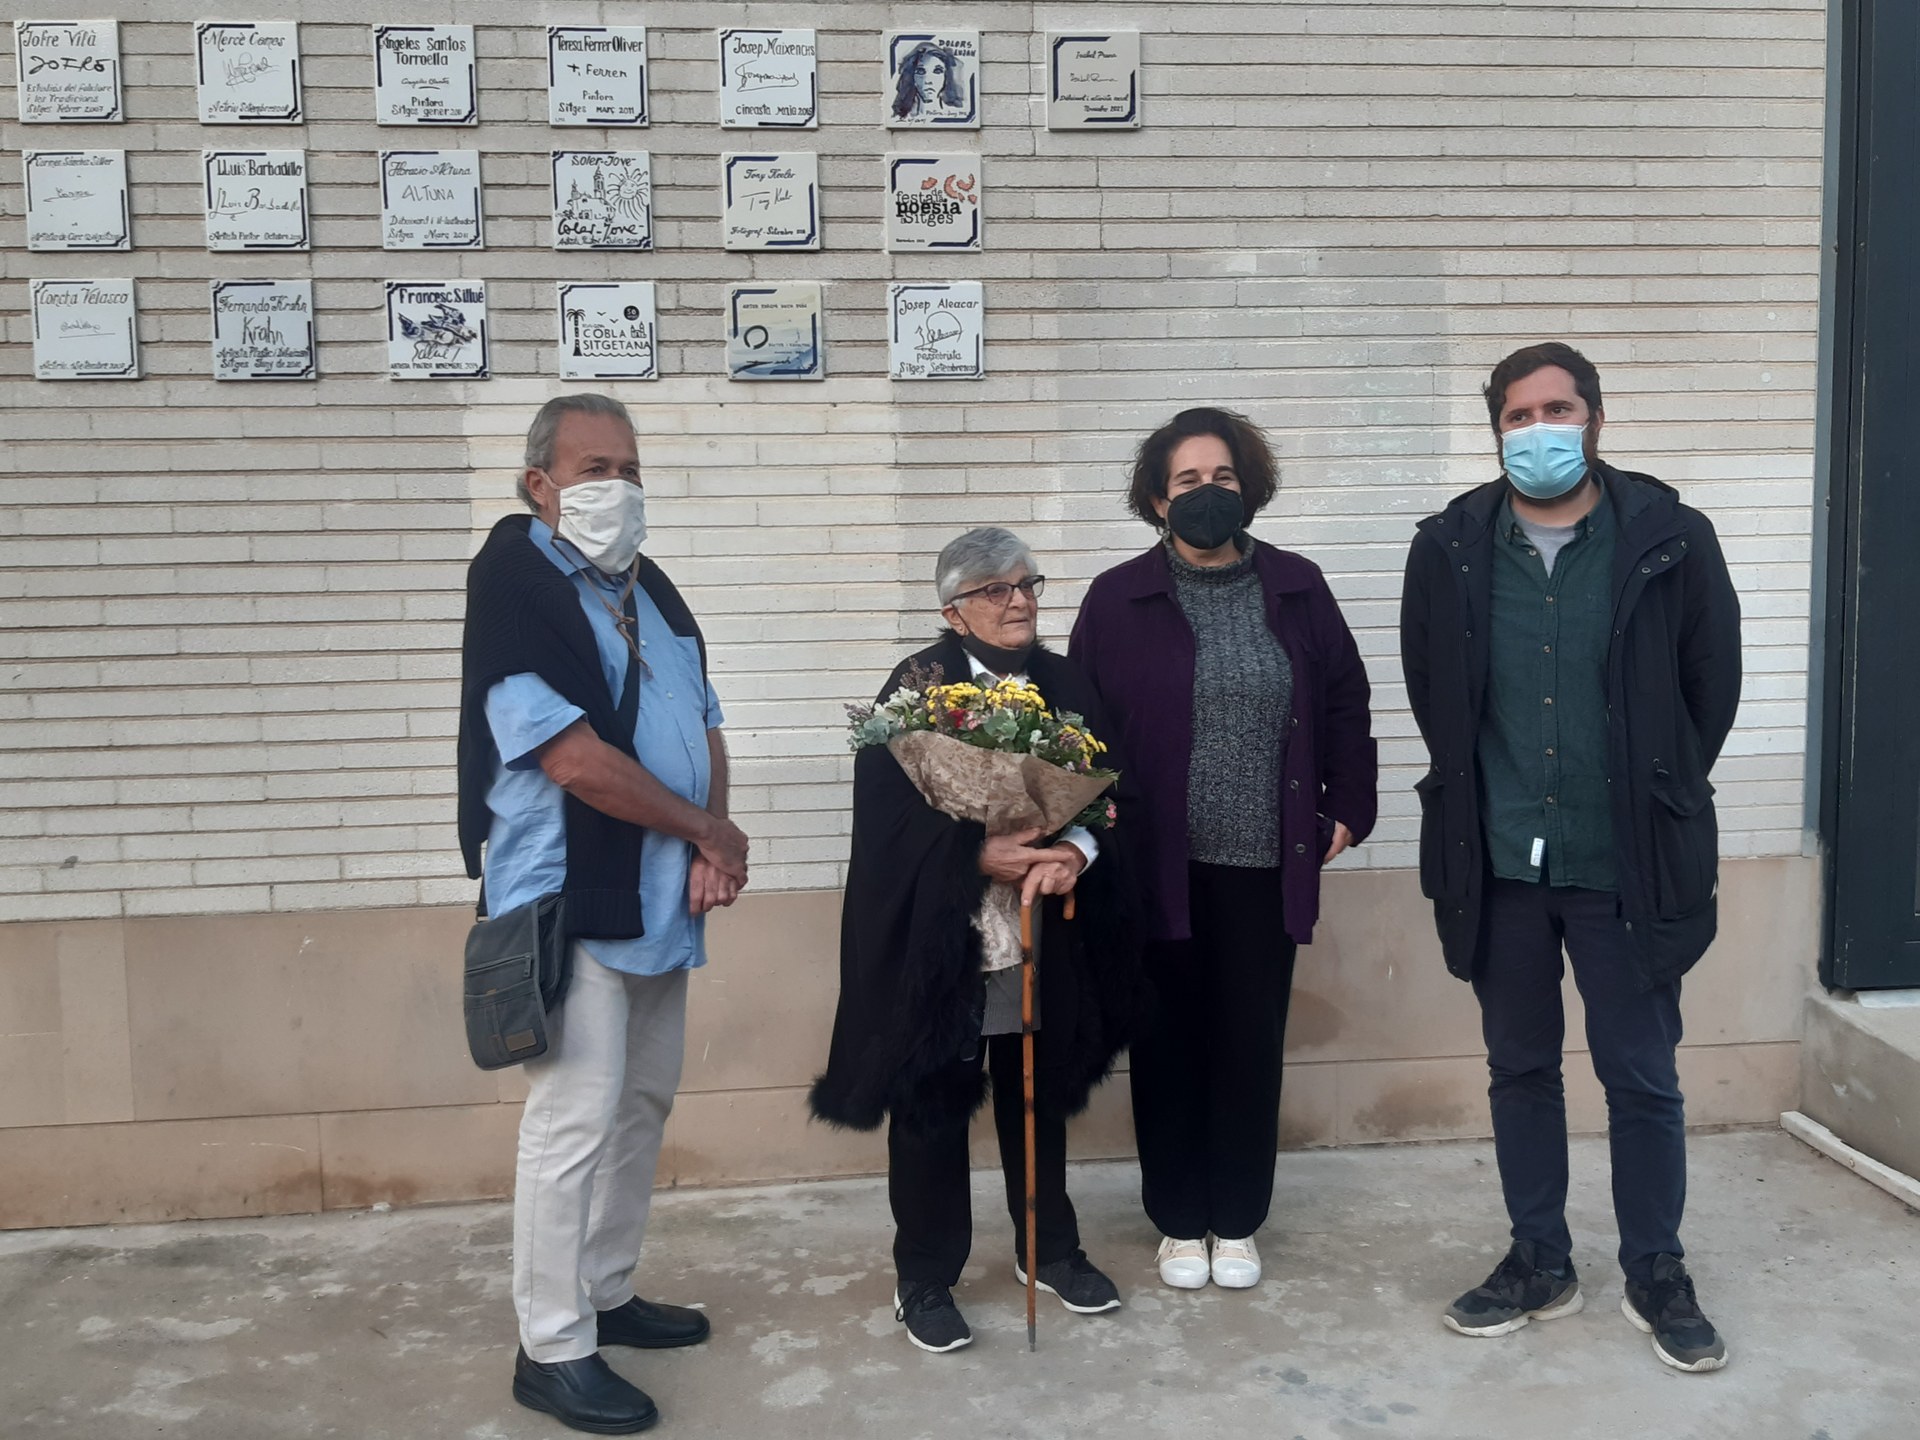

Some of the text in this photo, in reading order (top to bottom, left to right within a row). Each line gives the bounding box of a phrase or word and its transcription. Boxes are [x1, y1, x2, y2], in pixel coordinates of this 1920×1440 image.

[23, 29, 96, 47] Jofre Vilà
[426, 35, 467, 52] Santos
[555, 35, 643, 52] Teresa Ferrer Oliver
[733, 36, 763, 58] Josep
[393, 51, 449, 66] Torroella
[411, 96, 444, 107] Pintora
[558, 102, 587, 116] Sitges
[391, 104, 419, 117] Sitges
[896, 190, 933, 204] festa
[895, 198, 962, 217] poesia
[904, 212, 954, 227] Sitges
[80, 287, 129, 305] Velasco
[399, 287, 453, 304] Francesc
[217, 294, 270, 314] Fernando
[899, 299, 931, 316] Josep
[583, 328, 627, 339] COBLA
[583, 340, 653, 350] SITGETANA
[899, 361, 926, 375] Sitges
